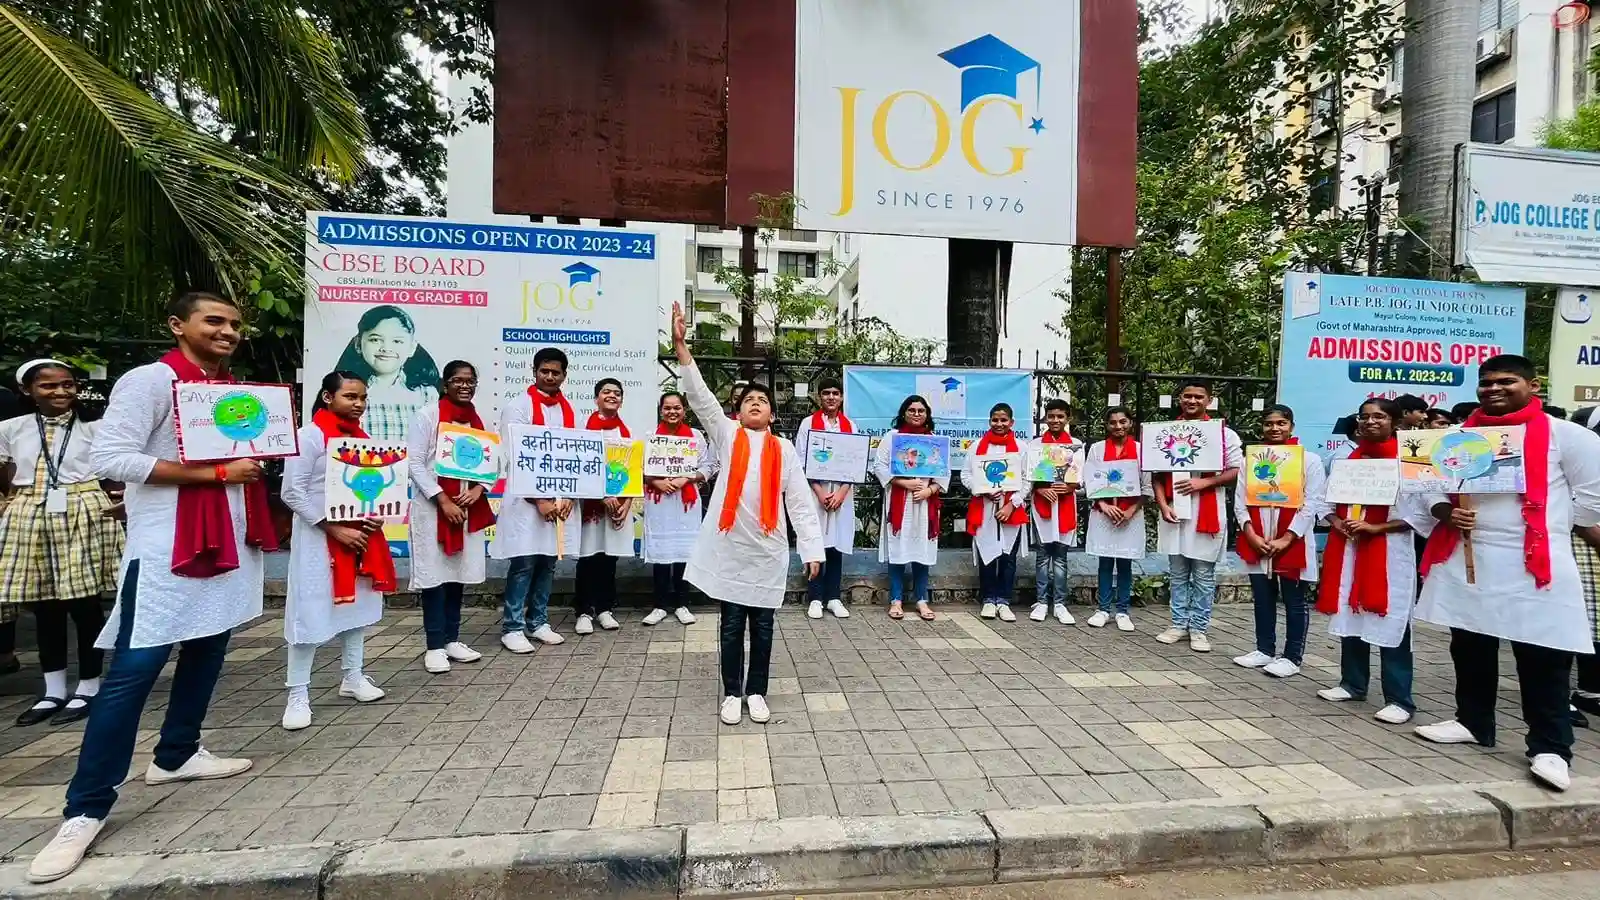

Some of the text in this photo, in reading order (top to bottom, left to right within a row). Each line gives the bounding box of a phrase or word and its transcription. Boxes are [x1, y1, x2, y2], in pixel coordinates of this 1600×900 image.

[827, 86, 1032, 217] JOG
[877, 189, 1025, 214] SINCE 1976
[1572, 194, 1590, 204] JOG
[1492, 201, 1520, 224] JOG
[1526, 204, 1589, 230] COLLEGE
[322, 223, 652, 254] ADMISSIONS OPEN FOR 2023 -24
[322, 253, 485, 277] CBSE BOARD
[322, 287, 484, 305] NURSERY TO GRADE 10
[520, 280, 595, 325] JOG
[1330, 296, 1360, 306] LATE
[1365, 297, 1384, 308] P.B.
[1388, 299, 1411, 309] JOG
[1415, 301, 1459, 312] JUNIOR
[1462, 304, 1517, 316] COLLEGE
[505, 331, 606, 343] SCHOOL HIGHLIGHTS
[1317, 321, 1340, 331] (Govt
[1342, 323, 1351, 331] of
[1353, 323, 1404, 333] Maharashtra
[1450, 329, 1468, 337] HSC
[1469, 330, 1495, 339] Board)
[624, 349, 646, 358] Staff
[1308, 337, 1442, 364] ADMISSIONS
[505, 361, 526, 369] Well
[582, 363, 634, 372] curriculum
[1360, 367, 1453, 383] FOR A.Y. 2023-24
[180, 391, 216, 404] SAVE
[268, 434, 291, 447] ME
[943, 430, 969, 438] MEDIUM
[517, 451, 536, 472] देश
[540, 454, 553, 472] की
[554, 455, 581, 474] सबसे
[536, 476, 578, 493] समस्या
